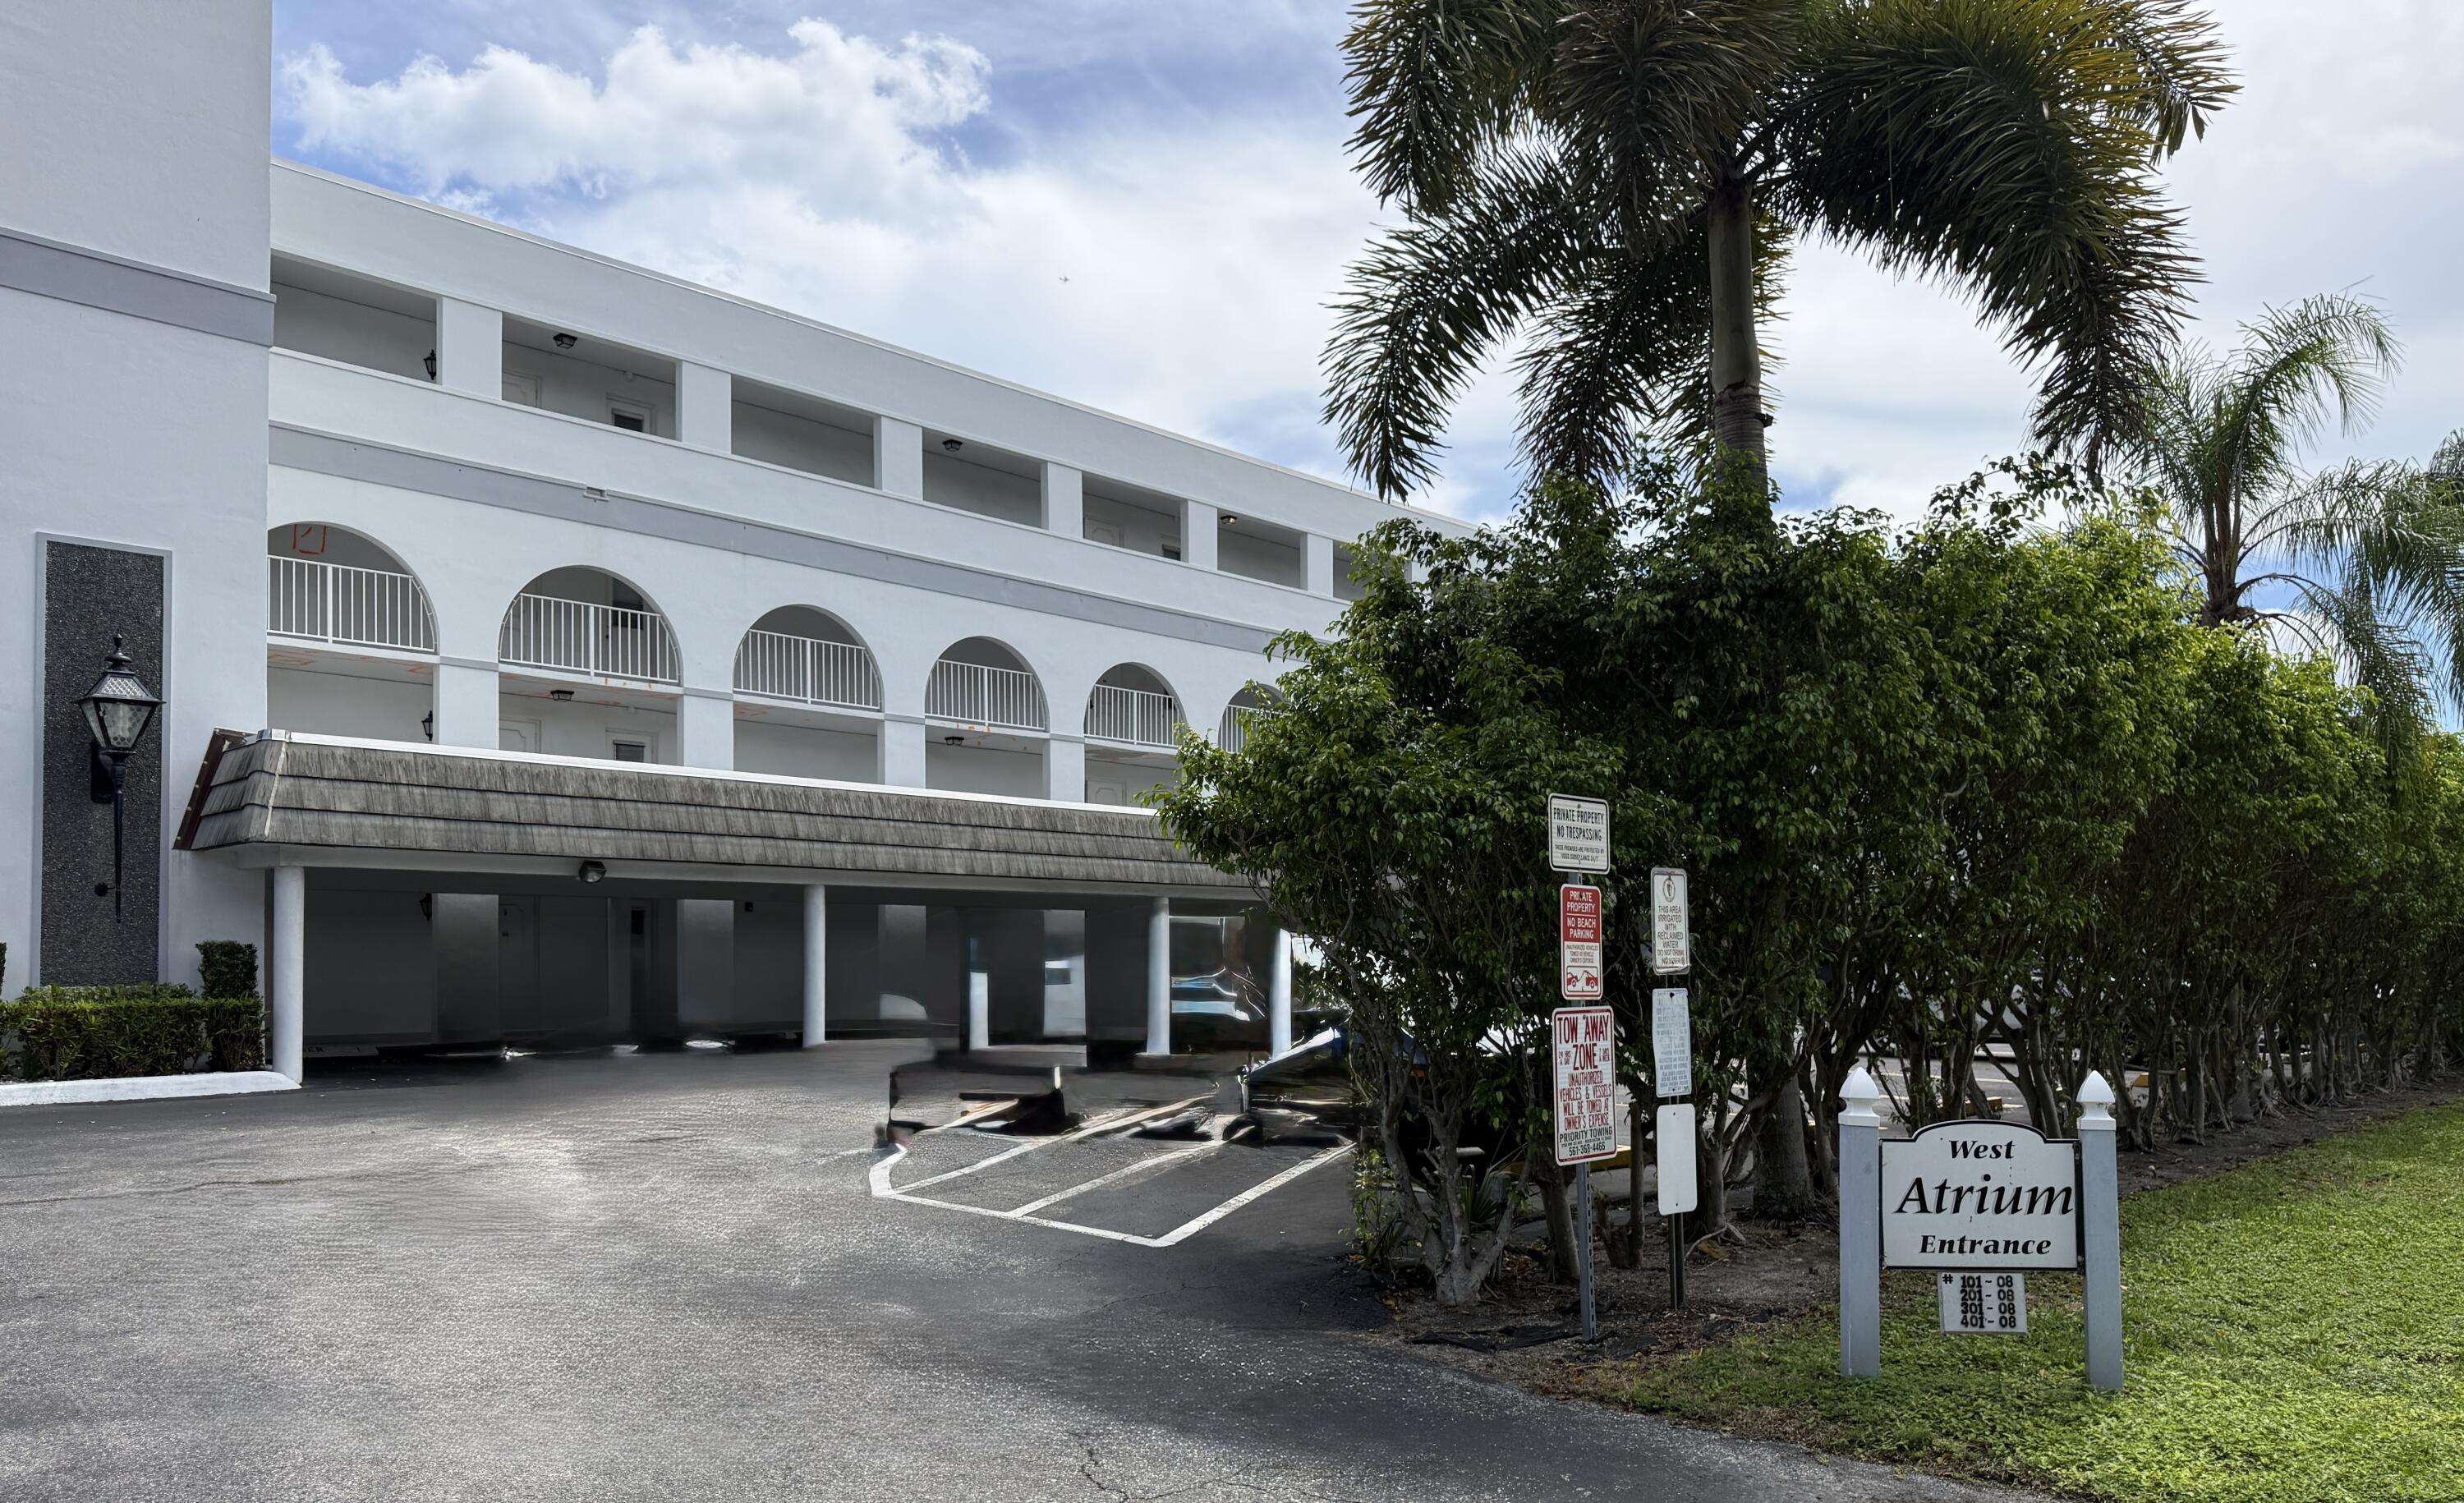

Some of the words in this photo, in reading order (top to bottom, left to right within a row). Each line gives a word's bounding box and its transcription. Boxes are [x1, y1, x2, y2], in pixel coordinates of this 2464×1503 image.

[1554, 807, 1575, 821] PRIVATE
[1577, 811, 1604, 825] PROPERTY
[1557, 825, 1565, 838] NO
[1566, 826, 1602, 841] TRESPASSING
[1567, 902, 1595, 912] PROPERTY
[1658, 905, 1668, 914] THIS
[1669, 906, 1681, 914] AREA
[1567, 917, 1575, 927] NO
[1577, 918, 1596, 928] BEACH
[1658, 914, 1681, 922] IRRIGATED
[1570, 929, 1593, 940] PARKING
[1664, 923, 1676, 931] WITH
[1657, 931, 1684, 940] RECLAIMED
[1662, 940, 1678, 949] WATER
[1557, 1016, 1578, 1044] TOW
[1584, 1014, 1609, 1042] AWAY
[1573, 1043, 1597, 1070] ZONE
[1568, 1070, 1603, 1087] UNAUTHORIZED
[1560, 1087, 1582, 1102] VEHICLES
[1585, 1086, 1590, 1099] &
[1593, 1083, 1611, 1098] VESSELS
[1563, 1102, 1574, 1116] WILL
[1577, 1101, 1584, 1115] BE
[1586, 1099, 1602, 1114] TOWED
[1604, 1098, 1609, 1112] AT
[1565, 1115, 1586, 1131] OWNER'S
[1588, 1112, 1609, 1128] EXPENSE
[1559, 1129, 1588, 1143] PRIORITY
[1589, 1126, 1613, 1138] TOWING
[1949, 1138, 2015, 1160] West
[1892, 1174, 2073, 1216] Atrium
[1919, 1234, 2052, 1255] Entrance
[1942, 1274, 1953, 1284] #
[1961, 1275, 1982, 1288] 101
[1997, 1275, 2013, 1288] 08
[1960, 1288, 1984, 1302] 201
[1997, 1289, 2015, 1302] 08
[1961, 1302, 1984, 1315] 301
[1998, 1303, 2016, 1315] 08
[1961, 1315, 1985, 1328] 401
[1999, 1316, 2016, 1328] 08
